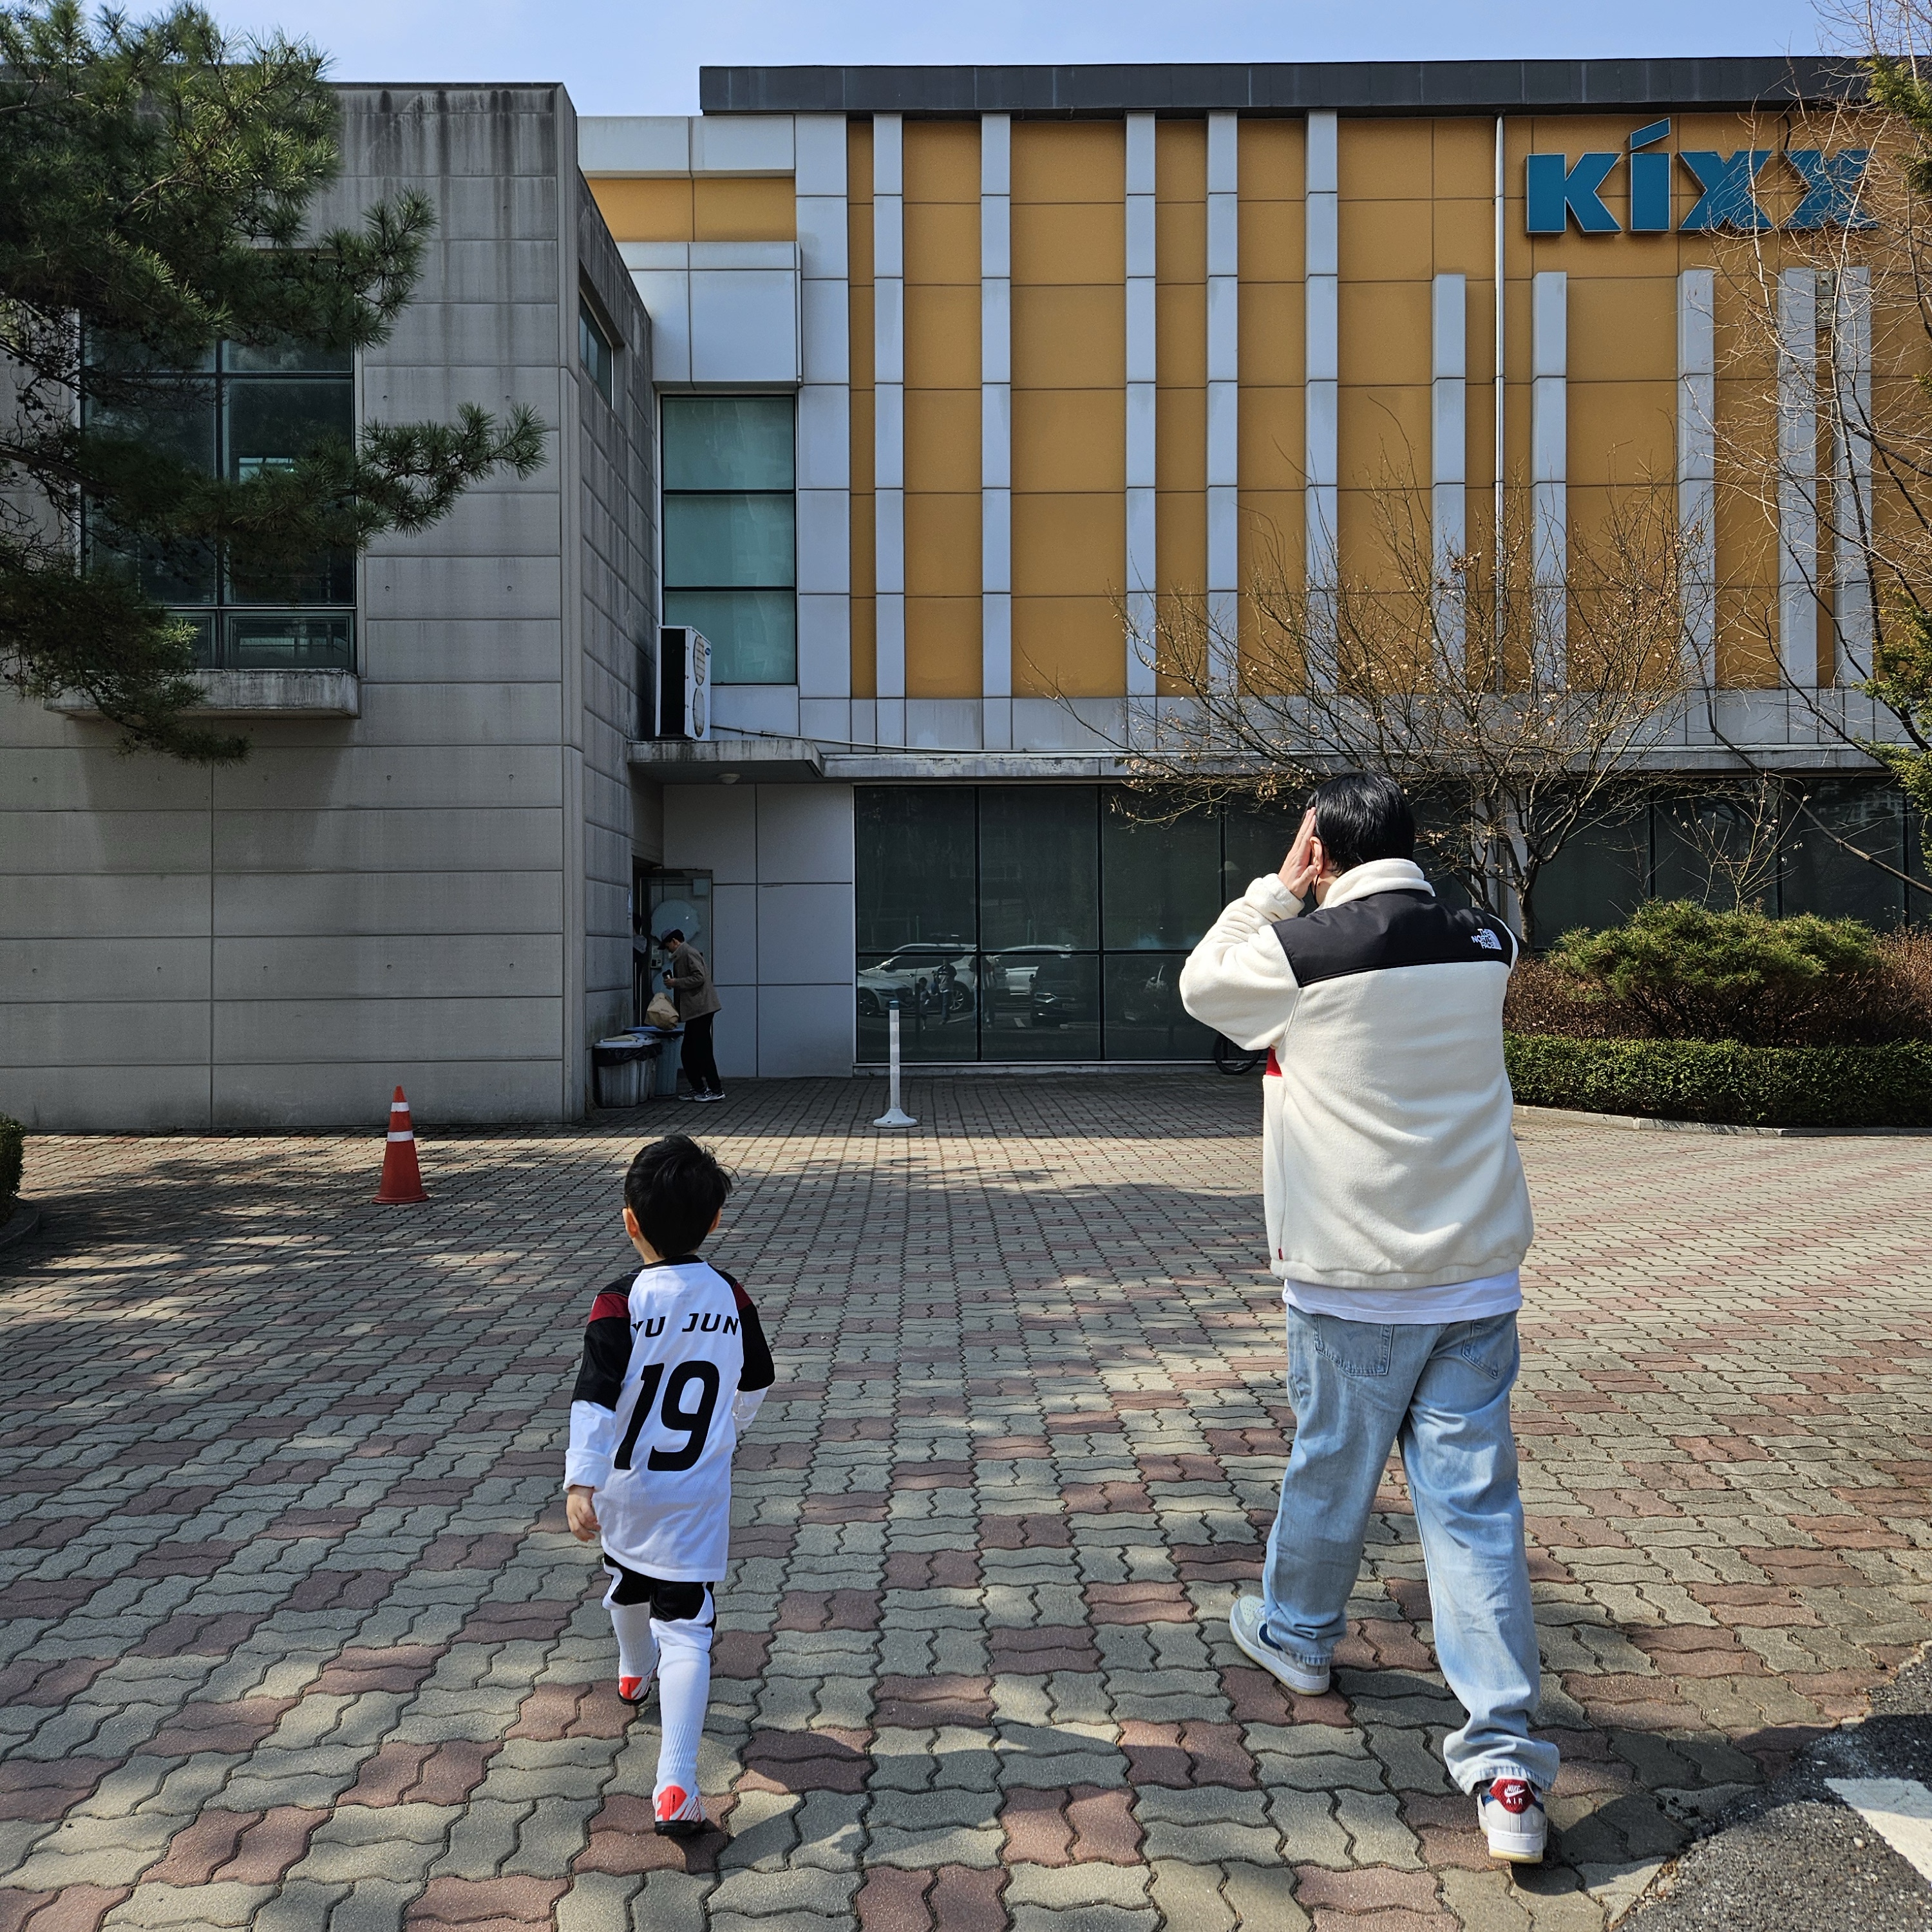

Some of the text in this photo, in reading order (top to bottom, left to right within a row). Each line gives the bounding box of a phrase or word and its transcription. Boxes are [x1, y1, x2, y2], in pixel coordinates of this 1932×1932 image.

[1470, 934, 1492, 943] NORTH
[682, 1312, 739, 1336] JUN
[613, 1360, 720, 1472] 19
[1506, 1784, 1521, 1793] NIKE
[1506, 1797, 1524, 1805] AIR
